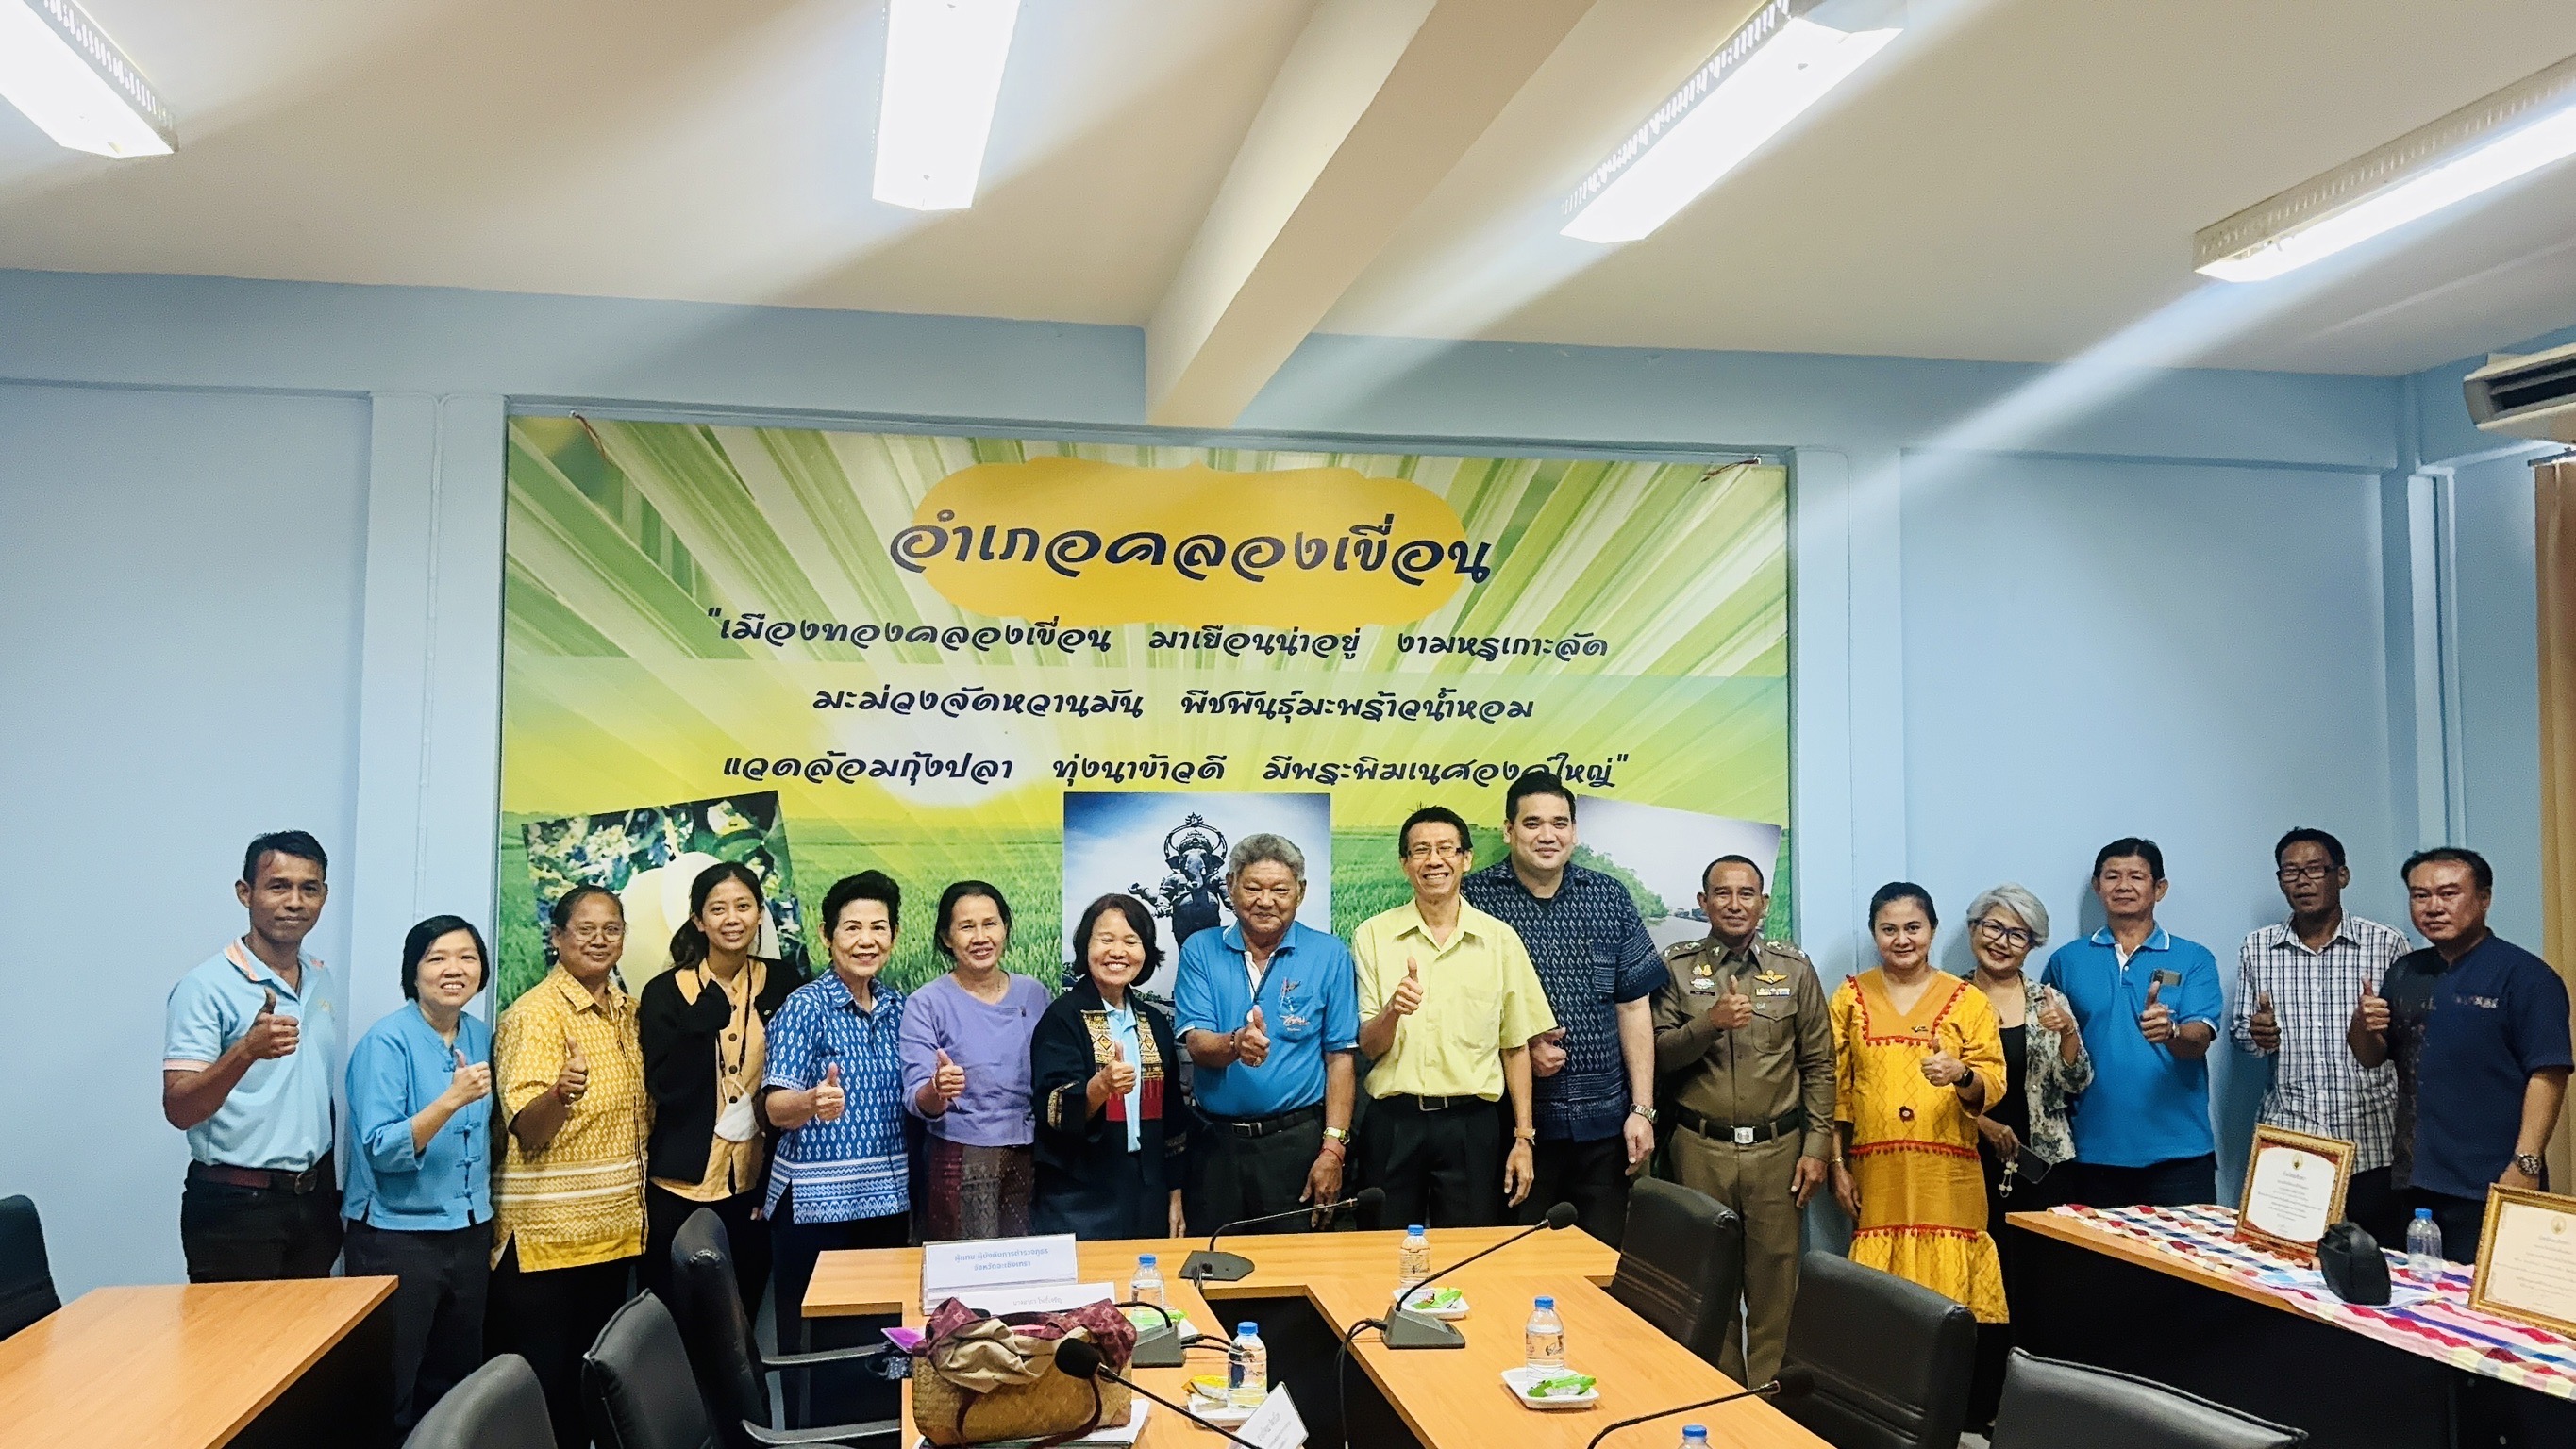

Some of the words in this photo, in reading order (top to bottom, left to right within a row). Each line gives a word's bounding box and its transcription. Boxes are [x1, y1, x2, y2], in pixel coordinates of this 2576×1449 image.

[890, 509, 1492, 586] อำเภอคลองเขื่อน
[1148, 625, 1361, 659] มาเยือนน่าอยู่
[1397, 632, 1608, 661] งามหรูเกาะลัด
[812, 684, 1144, 718] มะม่วงจัดหวานมัน
[1180, 687, 1534, 724] พืชพันธุ์มะพร้าวน้ำหอม
[723, 750, 1012, 786] แวดล้อมกุ้งปลา
[1052, 753, 1227, 787] ทุ่งนาข้าวดี
